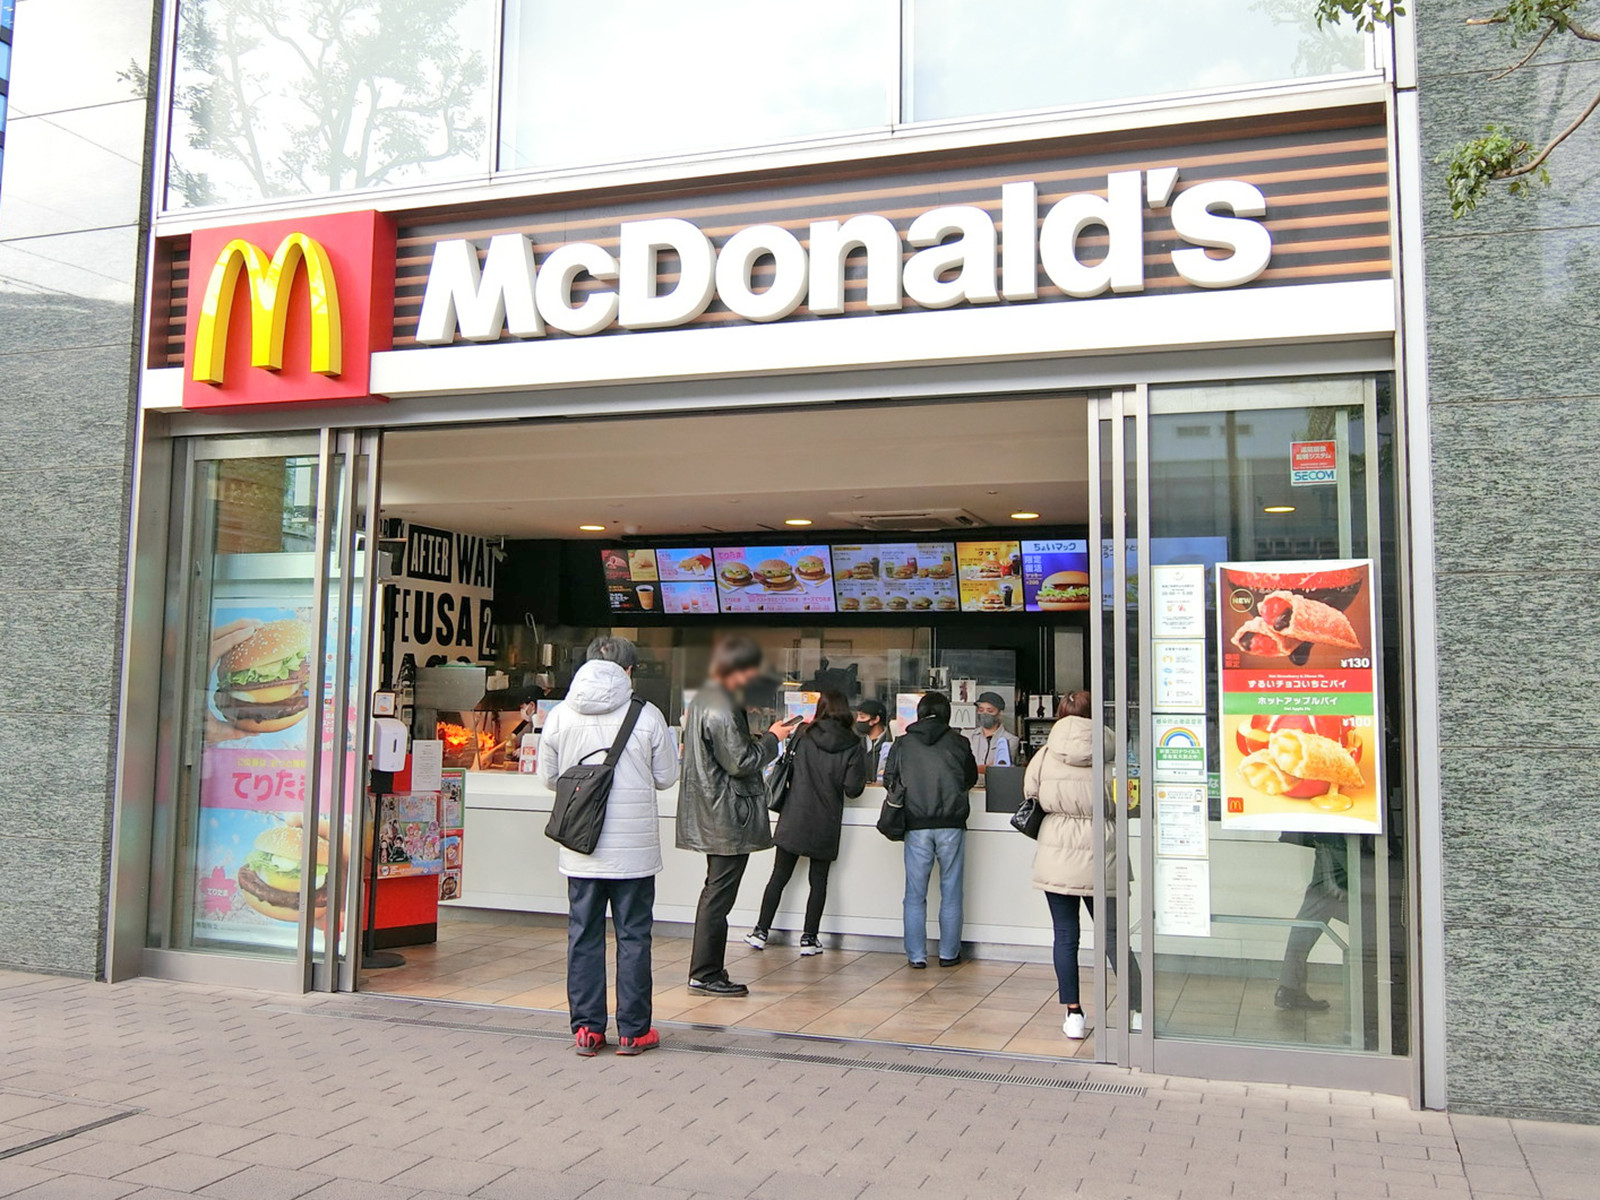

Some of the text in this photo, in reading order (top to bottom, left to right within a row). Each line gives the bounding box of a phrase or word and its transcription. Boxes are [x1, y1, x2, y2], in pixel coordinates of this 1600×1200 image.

[415, 167, 1273, 346] McDonald's
[1294, 470, 1335, 481] SECOM
[1033, 542, 1077, 552] ちょいマック
[410, 532, 450, 577] AFTER
[1340, 658, 1370, 668] ¥130
[1257, 696, 1338, 705] ホットアップルパイ
[1342, 717, 1372, 727] ¥100
